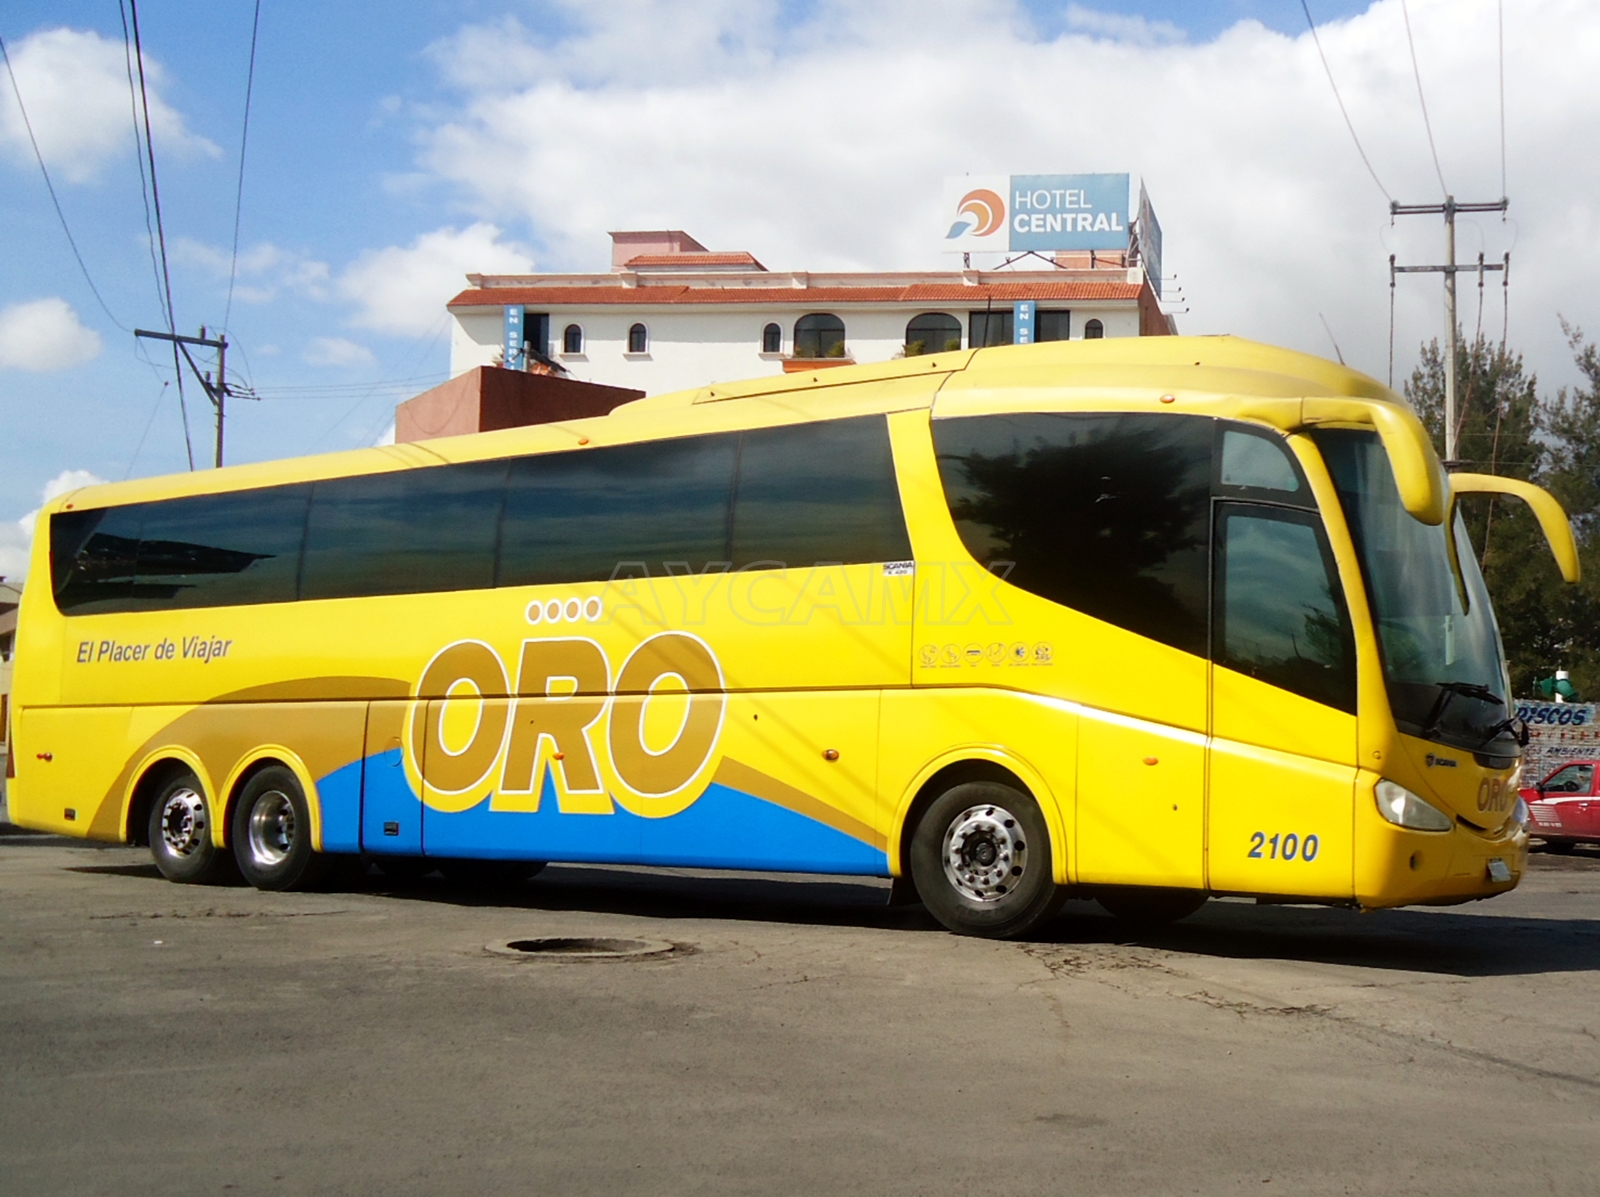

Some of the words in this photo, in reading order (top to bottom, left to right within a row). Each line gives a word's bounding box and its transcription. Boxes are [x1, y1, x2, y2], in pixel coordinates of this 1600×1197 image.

[1015, 189, 1092, 210] HOTEL
[1013, 212, 1123, 233] CENTRAL
[508, 308, 518, 324] EN
[1019, 304, 1029, 320] EN
[883, 562, 913, 570] SCANIA
[76, 641, 94, 663] El
[97, 640, 151, 663] Placer
[154, 637, 176, 660] de
[183, 635, 233, 664] Viajar
[409, 630, 728, 799] ORO
[1247, 831, 1319, 862] 2100
